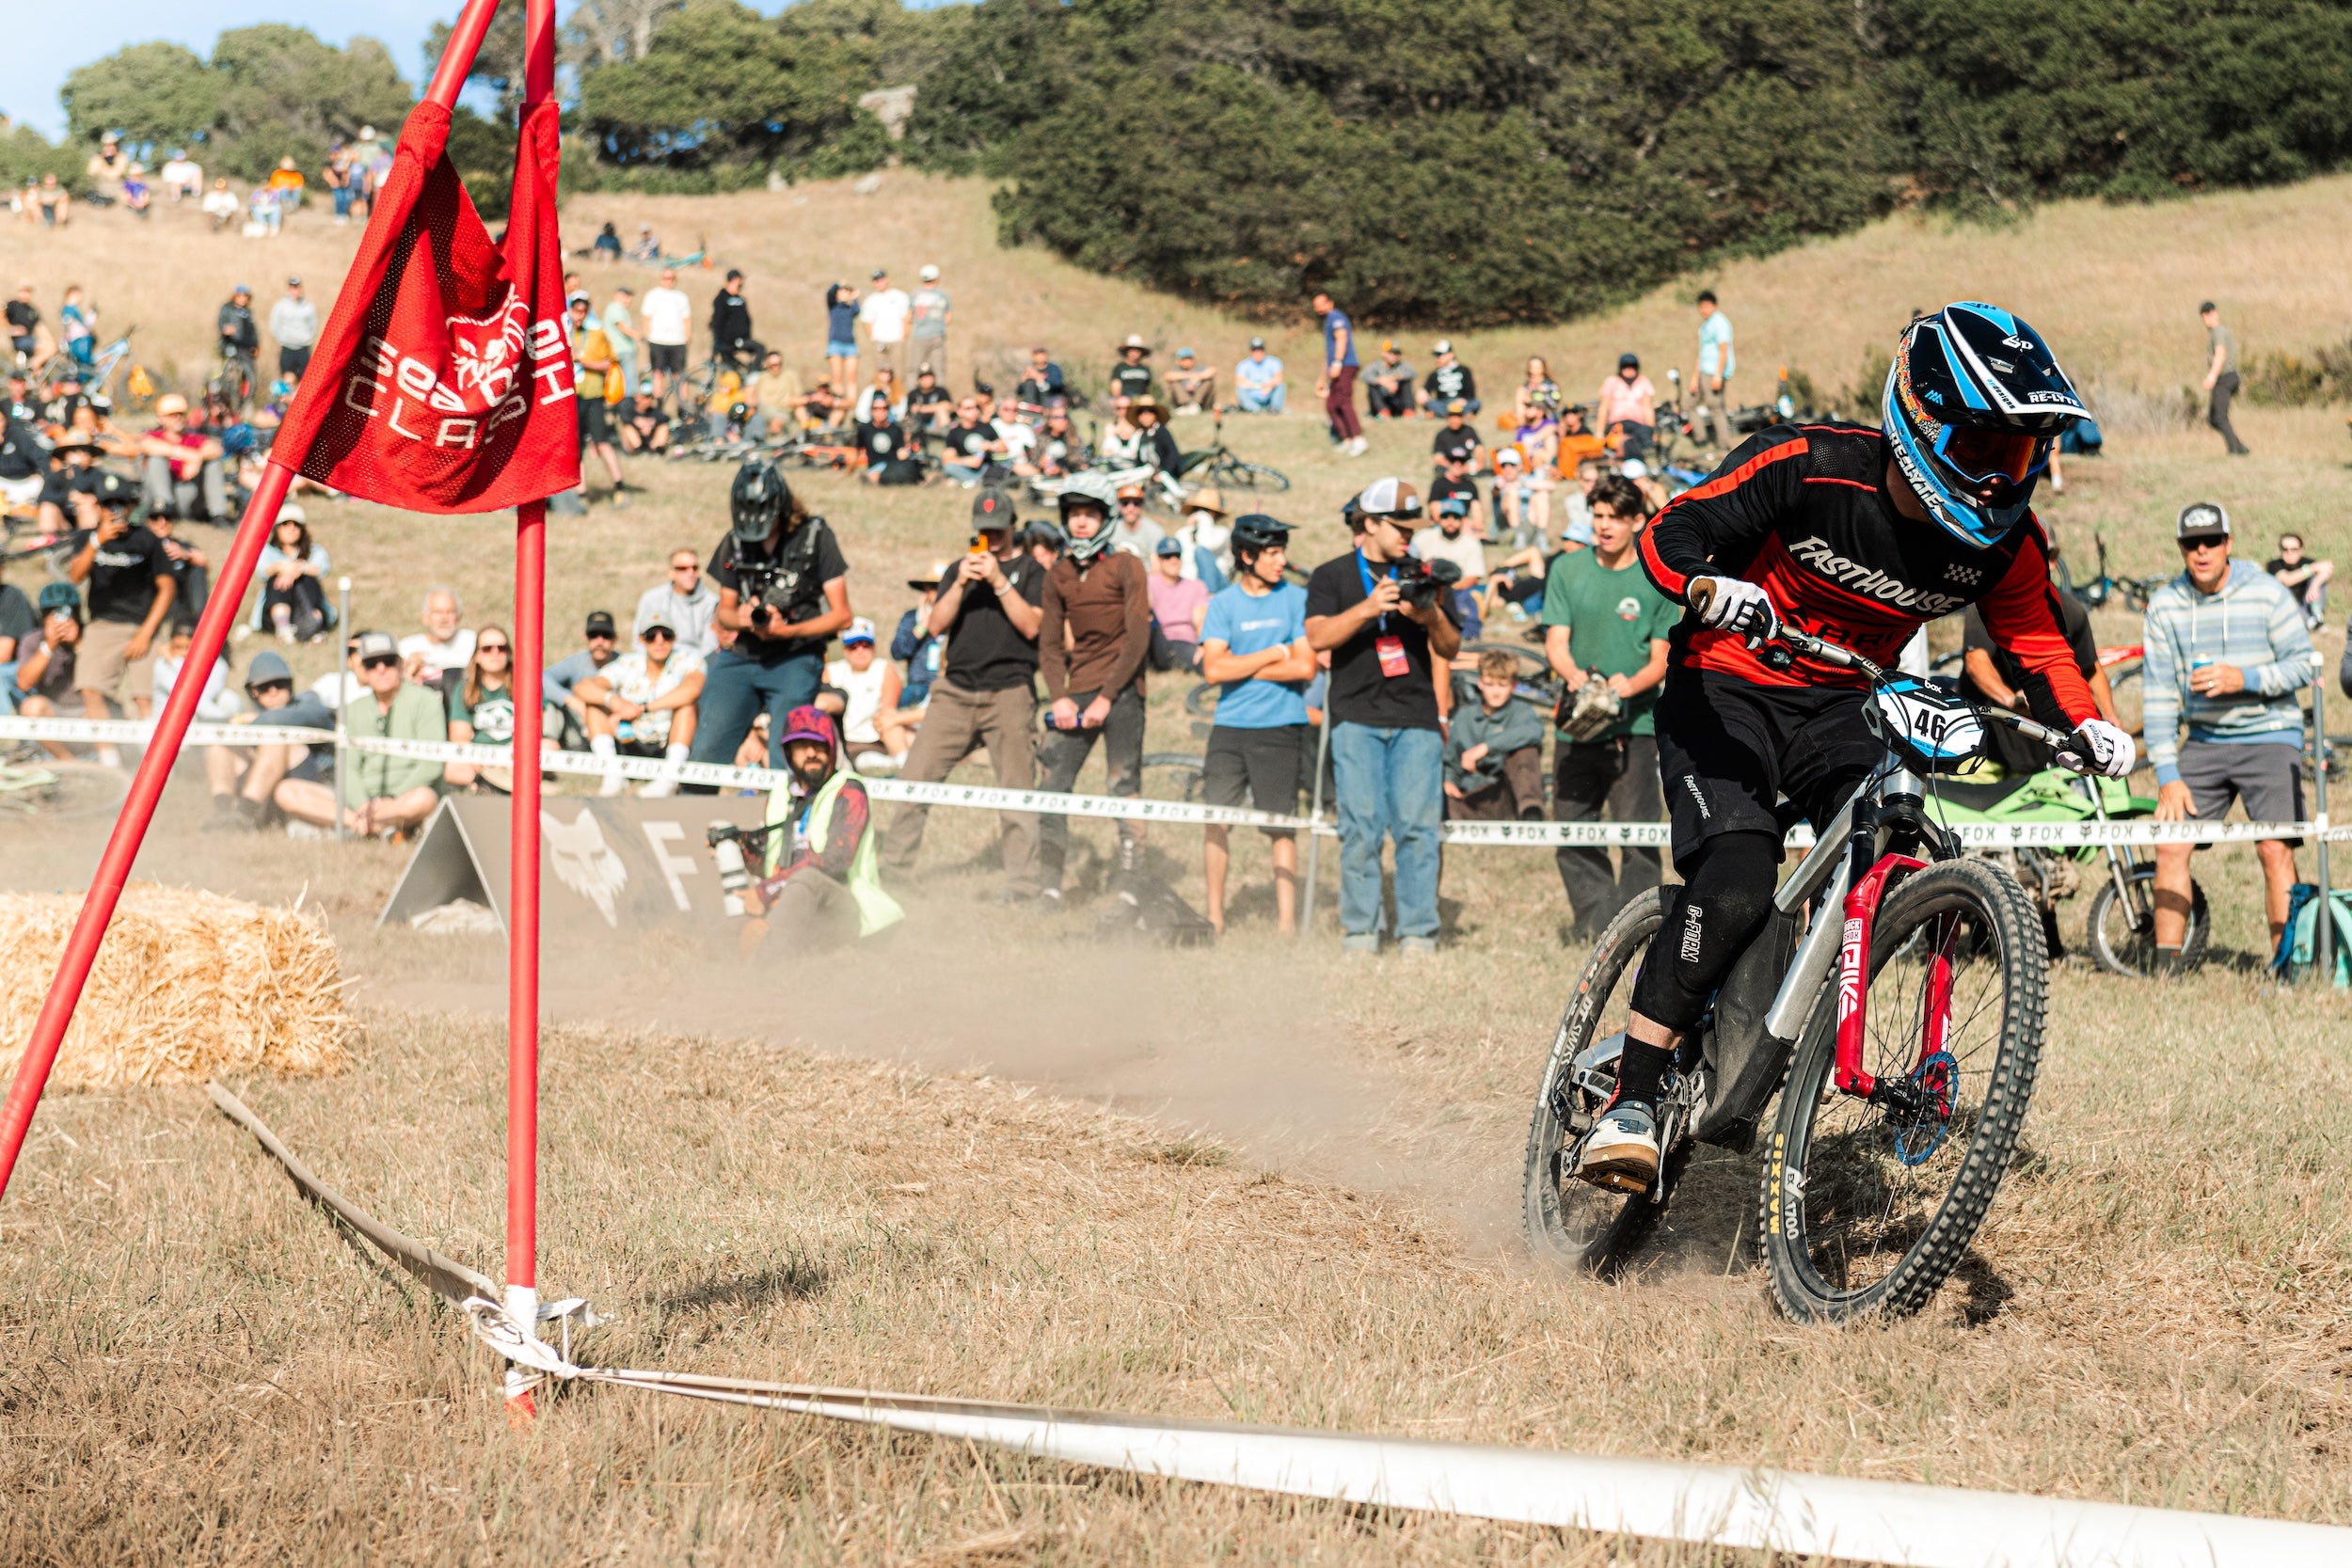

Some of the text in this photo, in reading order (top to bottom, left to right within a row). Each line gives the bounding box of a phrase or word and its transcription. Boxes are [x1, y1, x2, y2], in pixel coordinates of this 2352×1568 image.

[2028, 393, 2080, 407] RE-LYTE
[1911, 451, 1942, 492] REDMOND
[1788, 535, 1964, 613] FASTHOUSE
[1924, 679, 1942, 694] box
[1915, 708, 1947, 743] 46
[1098, 800, 1129, 814] FOX
[1683, 774, 1711, 820] FASTHOUSE
[1460, 825, 1669, 842] FOX FOX FOX FOX
[1963, 826, 1996, 842] FOX
[2029, 826, 2063, 841] FOX
[2099, 824, 2133, 839] FOX
[2169, 824, 2204, 838] FOX
[1680, 904, 1703, 963] G-FORM
[1836, 943, 1862, 1033] PIKE
[1580, 994, 1594, 1023] DT
[1561, 1024, 1582, 1066] SWISS
[1769, 1132, 1785, 1235] MAXXIS
[1784, 1201, 1800, 1241] 1700
